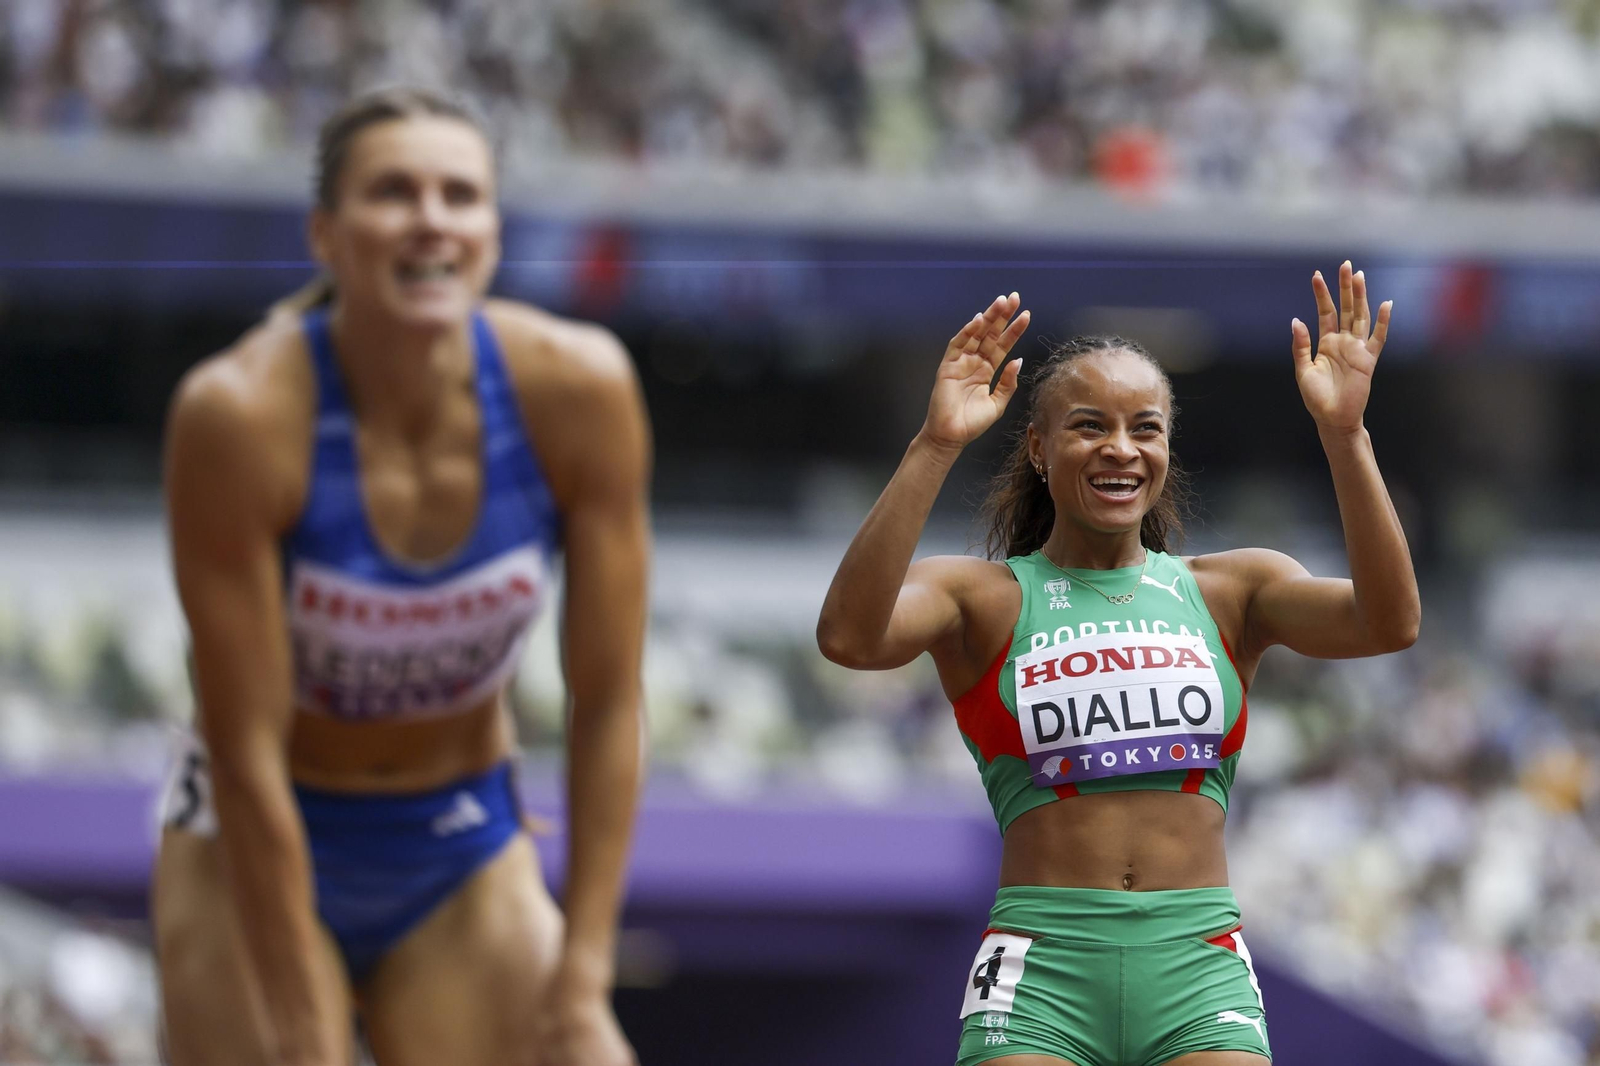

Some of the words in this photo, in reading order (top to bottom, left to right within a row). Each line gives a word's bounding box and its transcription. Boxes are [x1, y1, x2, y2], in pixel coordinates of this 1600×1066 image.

[1049, 601, 1073, 611] FPA
[1021, 646, 1211, 688] HONDA
[1031, 685, 1212, 745] DIALLO
[973, 946, 1006, 1000] 4
[985, 1035, 1009, 1046] FPA
